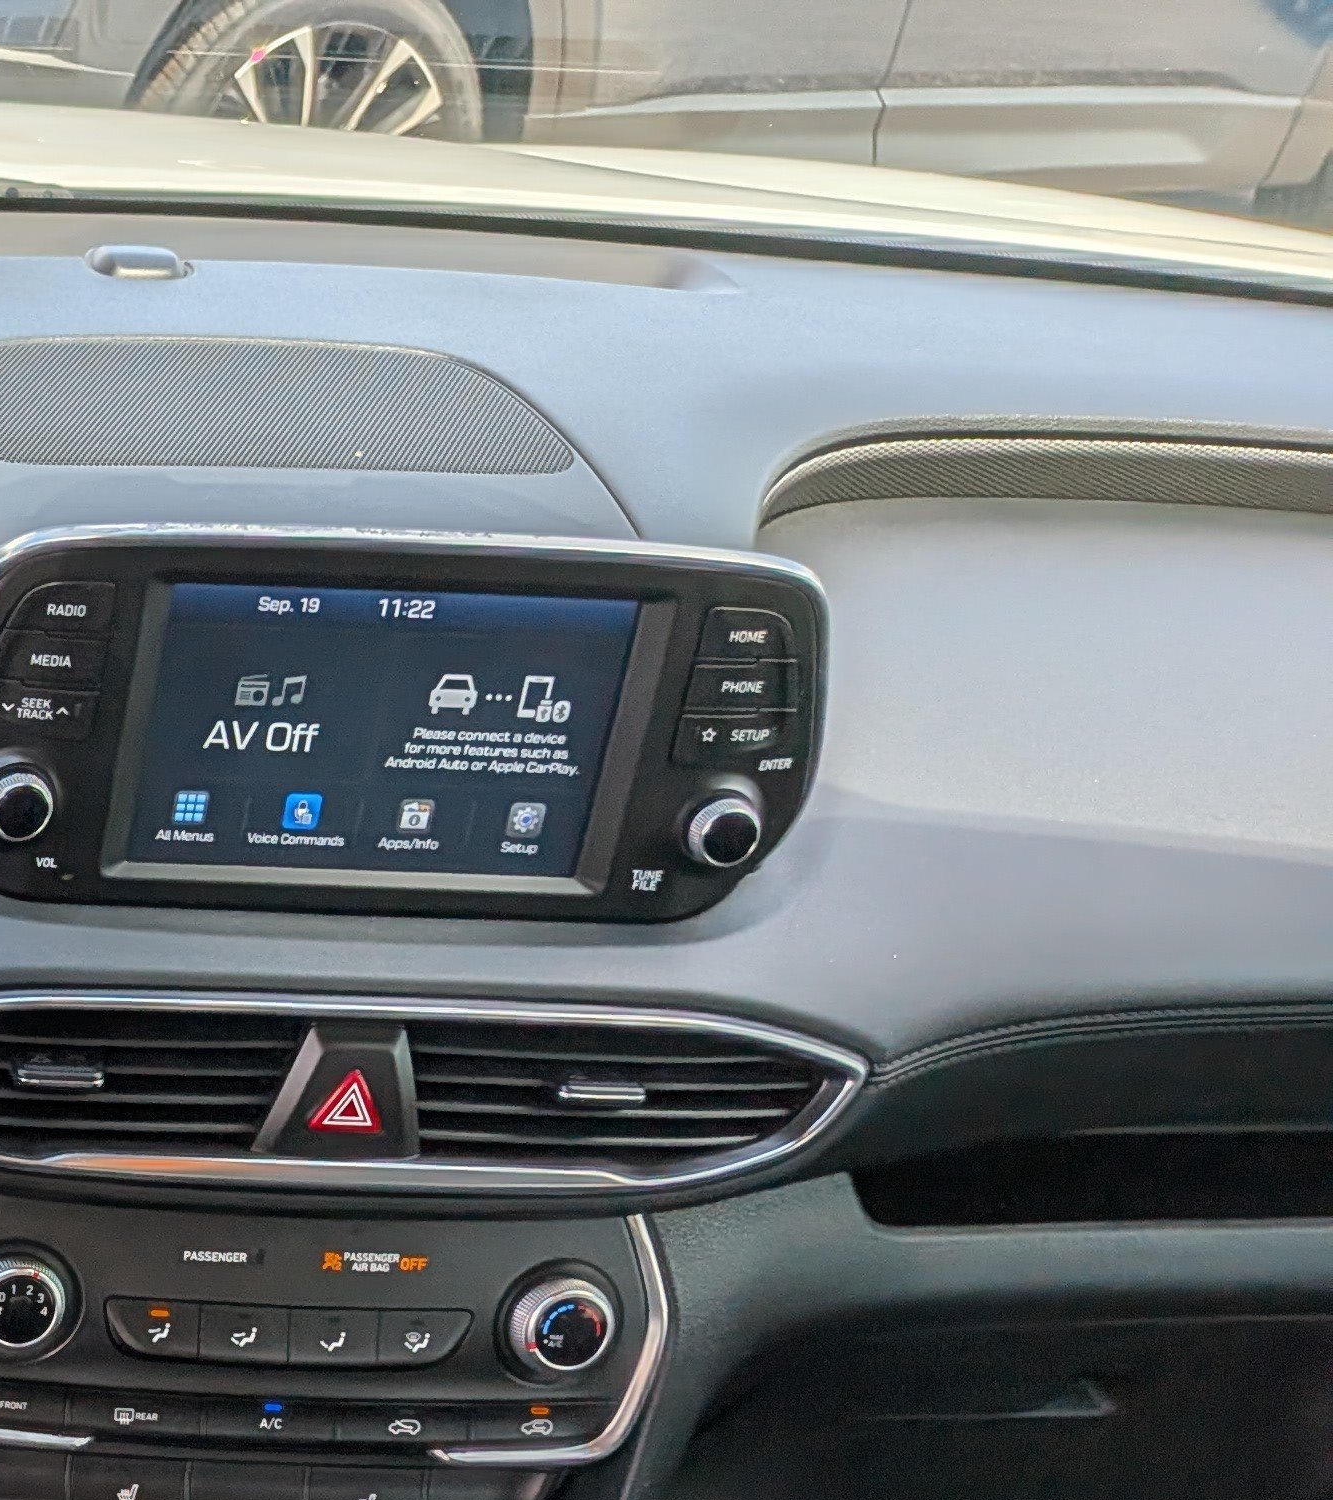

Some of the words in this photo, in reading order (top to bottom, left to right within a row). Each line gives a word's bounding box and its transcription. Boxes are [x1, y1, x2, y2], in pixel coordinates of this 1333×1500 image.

[46, 603, 87, 618] RADIO
[257, 596, 294, 615] Sep.
[300, 597, 321, 614] 19
[378, 598, 436, 620] 11:22
[729, 630, 768, 643] HOME
[29, 653, 72, 668] MEDIA
[721, 680, 765, 694] PHONE
[21, 697, 52, 710] SEEK
[16, 708, 54, 720] TRACK
[202, 720, 259, 751] AV
[265, 722, 321, 753] Off
[412, 727, 456, 741] Please
[457, 730, 511, 743] connect
[513, 734, 522, 743] a
[524, 732, 567, 745] device
[730, 728, 770, 742] SETUP
[404, 742, 425, 755] for
[426, 745, 461, 756] more
[463, 744, 518, 758] features
[520, 747, 551, 760] such
[552, 750, 569, 760] as
[384, 756, 436, 770] Android
[438, 758, 468, 771] Auto
[470, 761, 487, 771] or
[487, 760, 526, 774] Apple
[525, 762, 581, 777] CarPlay.
[758, 757, 793, 772] ENTER
[155, 829, 171, 841] All
[172, 830, 215, 843] Menus
[247, 832, 279, 845] Voice
[280, 833, 345, 847] Commands
[377, 837, 440, 851] Apps/Info
[500, 841, 539, 856] Setup
[35, 857, 58, 869] VOL
[632, 869, 664, 881] TUNE
[631, 879, 658, 891] FILE
[183, 1250, 247, 1263] PASSENGER
[344, 1252, 400, 1263] PASSENGER
[352, 1262, 369, 1272] AIR
[370, 1262, 390, 1273] BAG
[400, 1256, 428, 1272] OFF
[11, 1285, 17, 1295] 1
[26, 1285, 34, 1296] 2
[37, 1293, 45, 1304] 3
[40, 1306, 48, 1316] 4
[0, 1400, 28, 1410] FRONT
[135, 1411, 159, 1421] REAR
[259, 1417, 282, 1430] A/C
